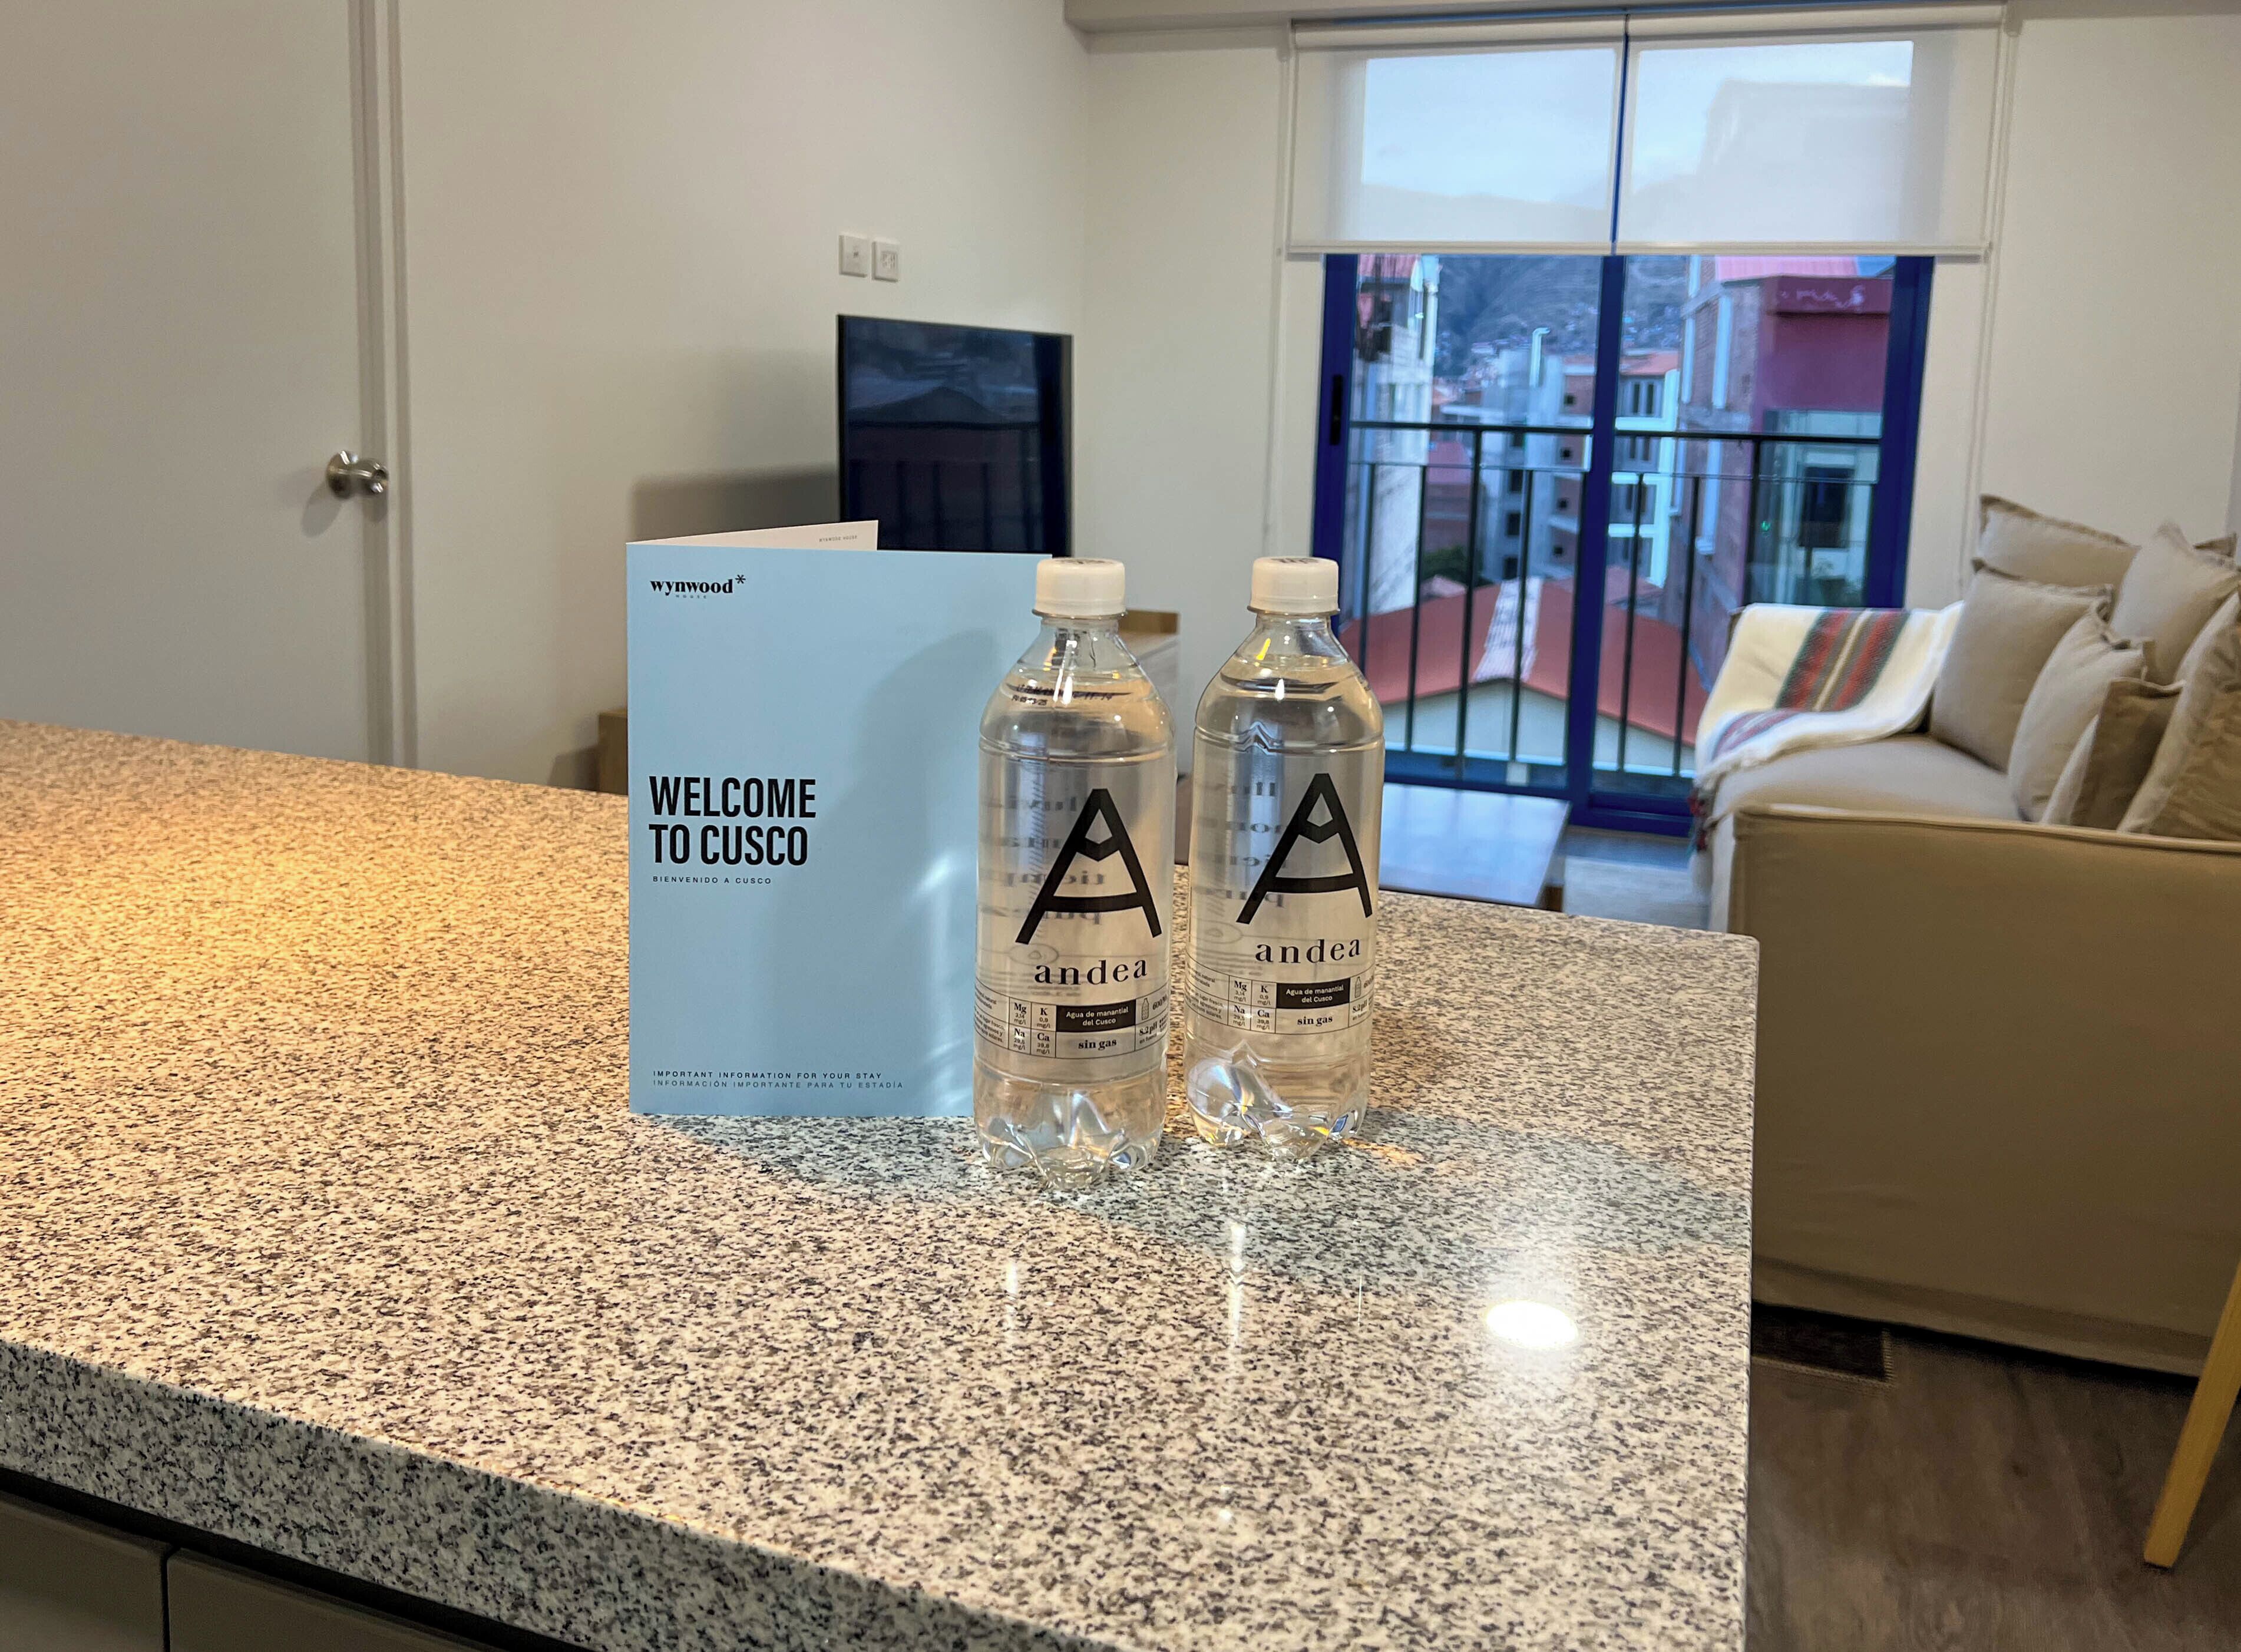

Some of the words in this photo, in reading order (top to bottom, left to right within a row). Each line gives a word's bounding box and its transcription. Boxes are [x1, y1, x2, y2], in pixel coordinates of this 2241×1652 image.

[650, 579, 733, 596] wynwood
[649, 776, 816, 818] WELCOME
[649, 824, 690, 864] TO
[701, 825, 808, 865] CUSCO
[653, 875, 718, 884] BIENVENIDO
[1255, 939, 1360, 964] andea
[1035, 959, 1147, 985] andea
[1234, 980, 1247, 992] Mg
[1314, 985, 1344, 994] manantial
[1014, 1002, 1026, 1015] Mg
[1040, 1007, 1047, 1016] K
[1066, 1011, 1083, 1019] Agua
[1096, 1007, 1129, 1016] manantial
[1234, 1005, 1245, 1014] Na
[1257, 1009, 1270, 1018] Ca
[1297, 1016, 1314, 1025] sin
[1316, 1016, 1333, 1026] gas
[1014, 1028, 1025, 1038] Na
[1037, 1032, 1050, 1042] Ca
[1078, 1040, 1097, 1049] sin
[1099, 1039, 1117, 1051] gas
[653, 1079, 728, 1088] INFORMACIÓN
[858, 1080, 904, 1089] ESTADÍA
